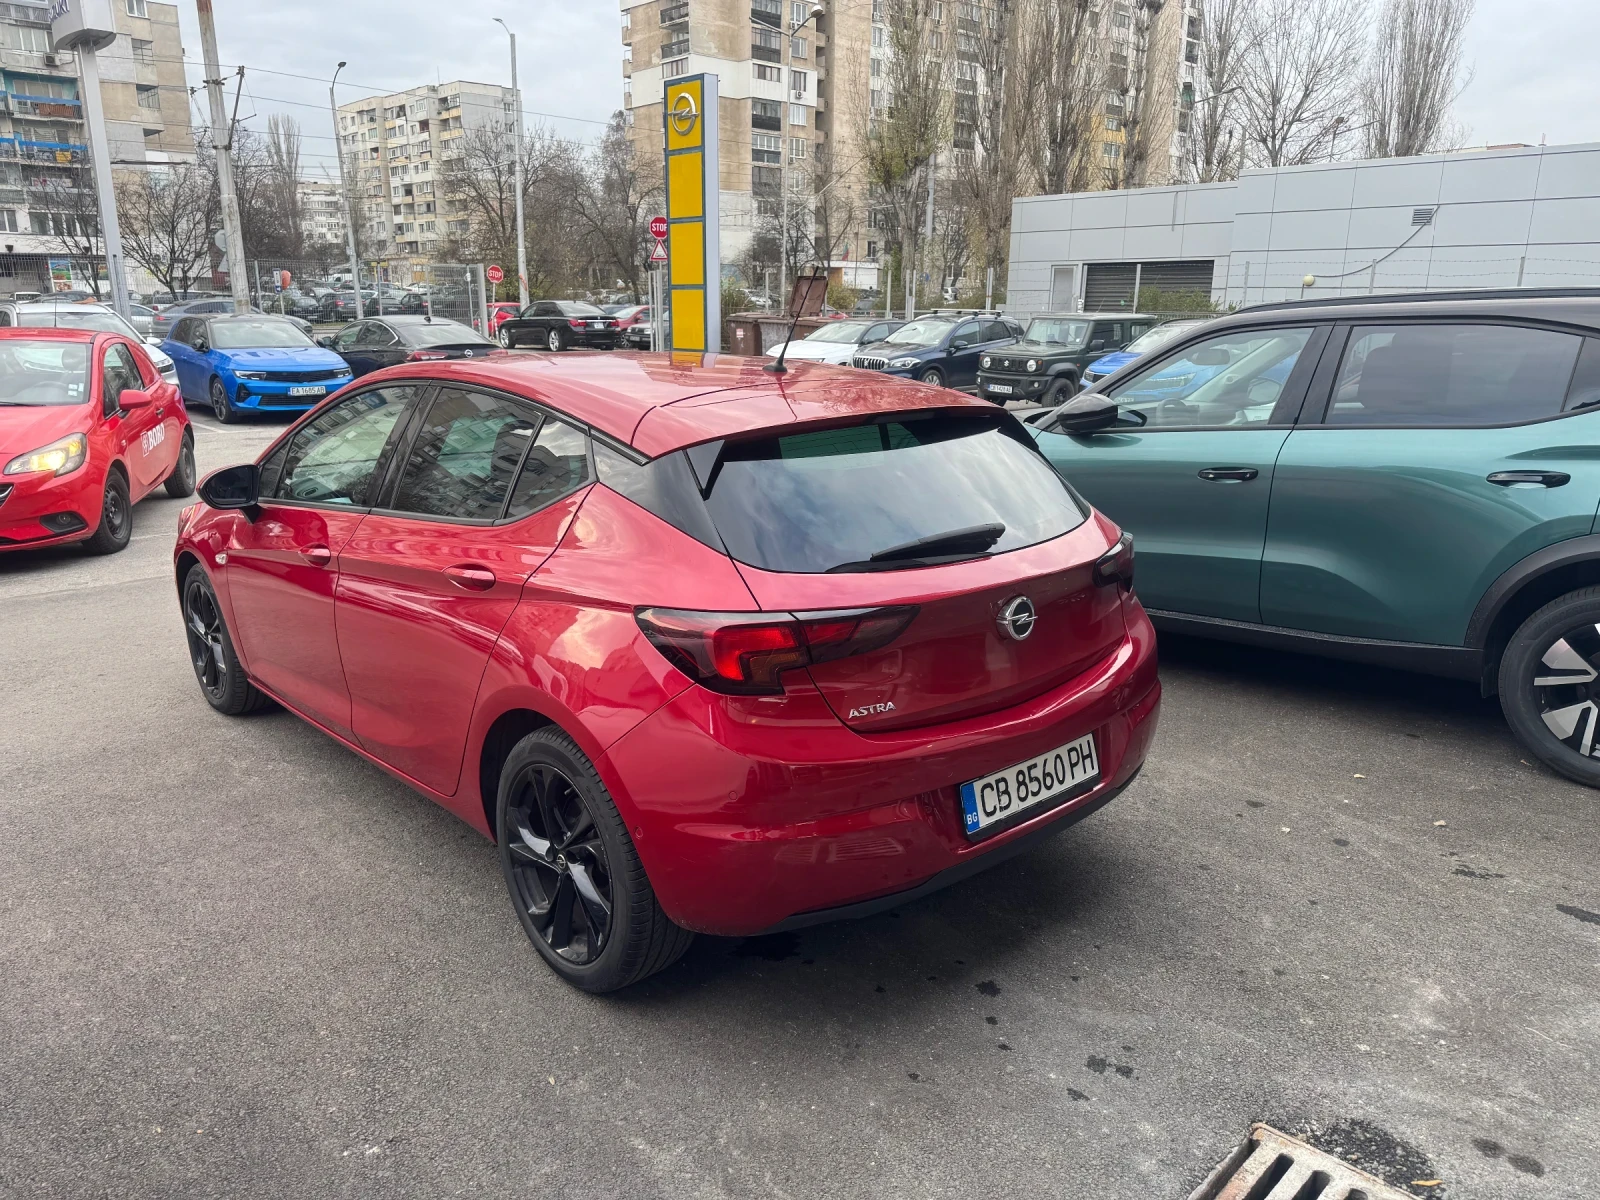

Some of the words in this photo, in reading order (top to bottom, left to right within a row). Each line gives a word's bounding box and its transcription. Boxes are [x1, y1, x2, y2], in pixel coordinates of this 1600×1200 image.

[488, 269, 502, 278] STOP
[848, 701, 896, 719] ASTRA
[966, 812, 978, 825] BG
[980, 777, 1012, 818] CB
[1015, 753, 1066, 803] 8560
[1067, 739, 1095, 780] PH
